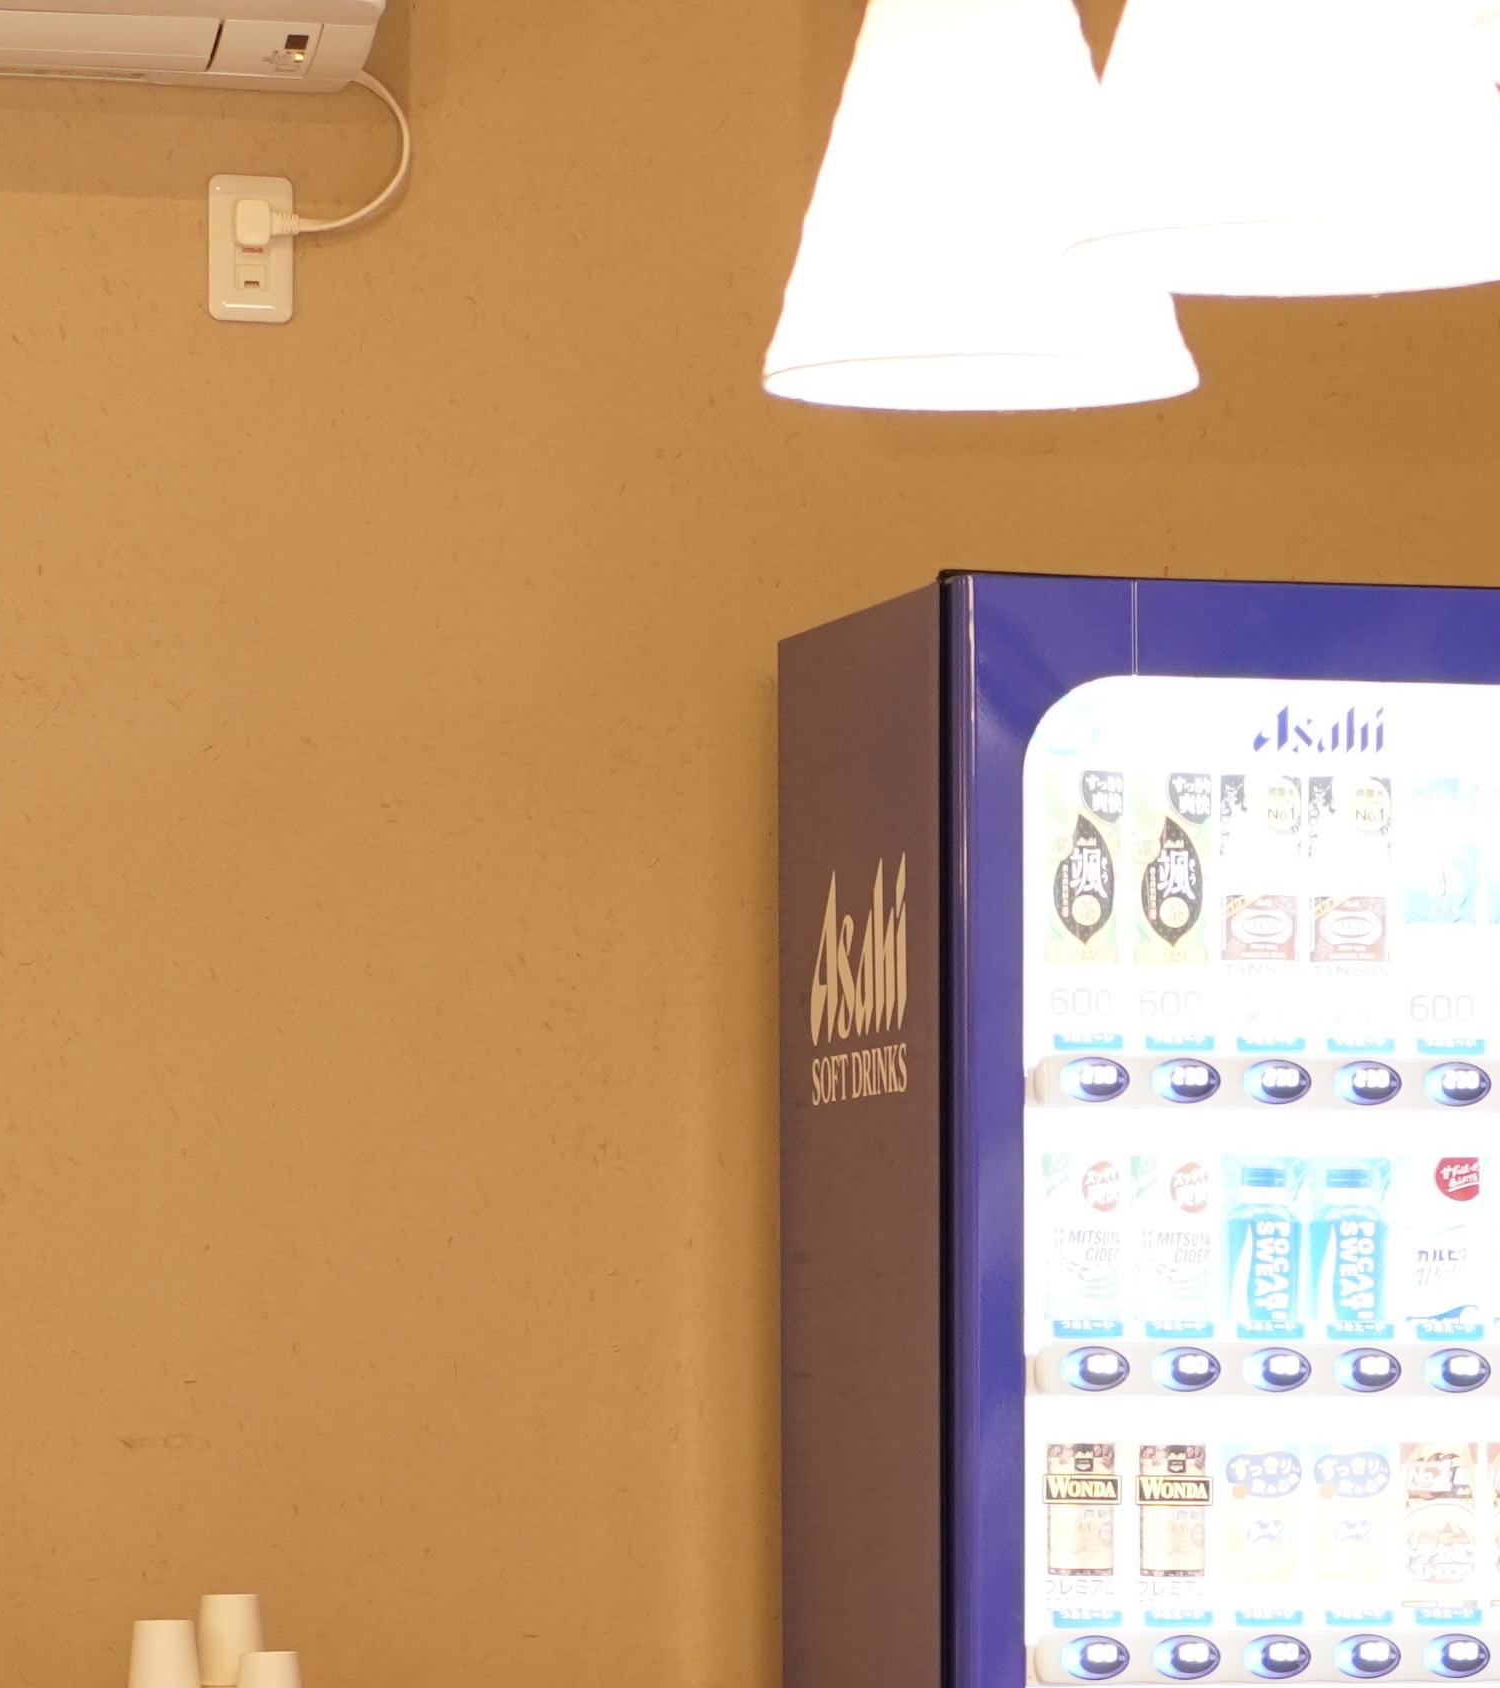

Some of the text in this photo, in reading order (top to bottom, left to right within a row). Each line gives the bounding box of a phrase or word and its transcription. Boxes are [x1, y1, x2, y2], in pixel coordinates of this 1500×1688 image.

[1253, 703, 1385, 754] Asahi
[811, 851, 907, 1046] Asahi
[812, 1043, 907, 1106] SOFT DRINKS
[1068, 1230, 1120, 1245] MITSUYA
[1157, 1232, 1210, 1246] MITSUYA
[1255, 1221, 1275, 1309] SWEAT
[1339, 1221, 1358, 1308] SWEAT
[1273, 1221, 1291, 1320] POCARI
[1358, 1221, 1375, 1319] POCARI
[1047, 1476, 1116, 1498] WONDA
[1140, 1477, 1208, 1499] WONDA
